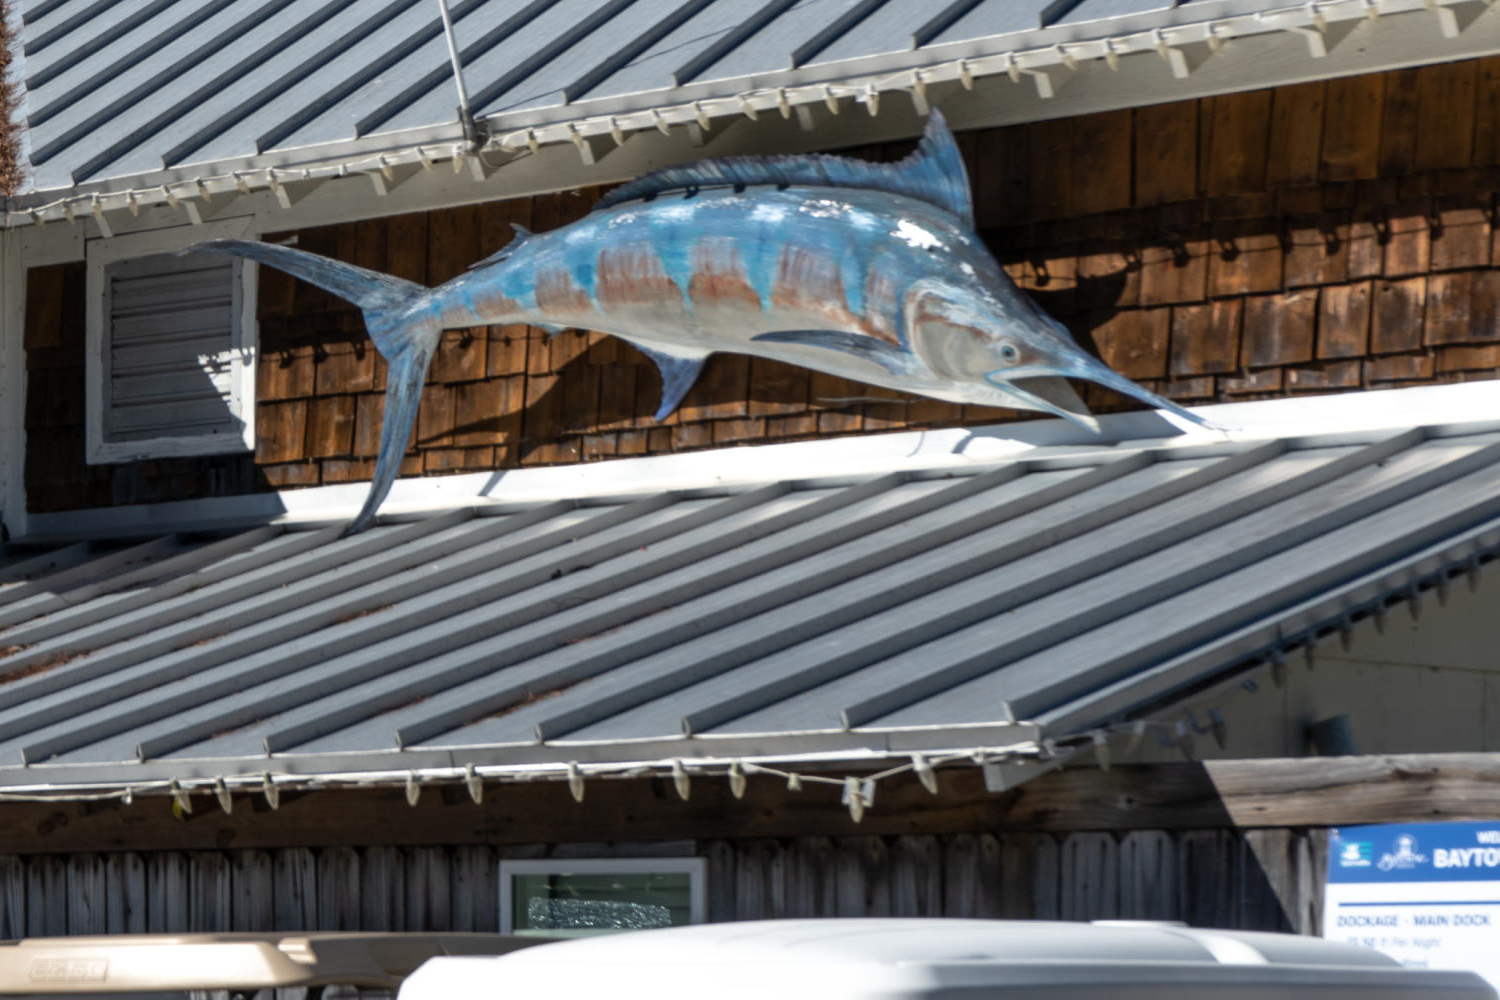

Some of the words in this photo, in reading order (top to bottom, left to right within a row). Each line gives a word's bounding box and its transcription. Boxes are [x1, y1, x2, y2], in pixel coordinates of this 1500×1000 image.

[1433, 848, 1500, 868] BAYTO
[1337, 914, 1398, 927] DOCKAGE
[1413, 914, 1448, 926] MAIN
[1453, 914, 1491, 926] DOCK
